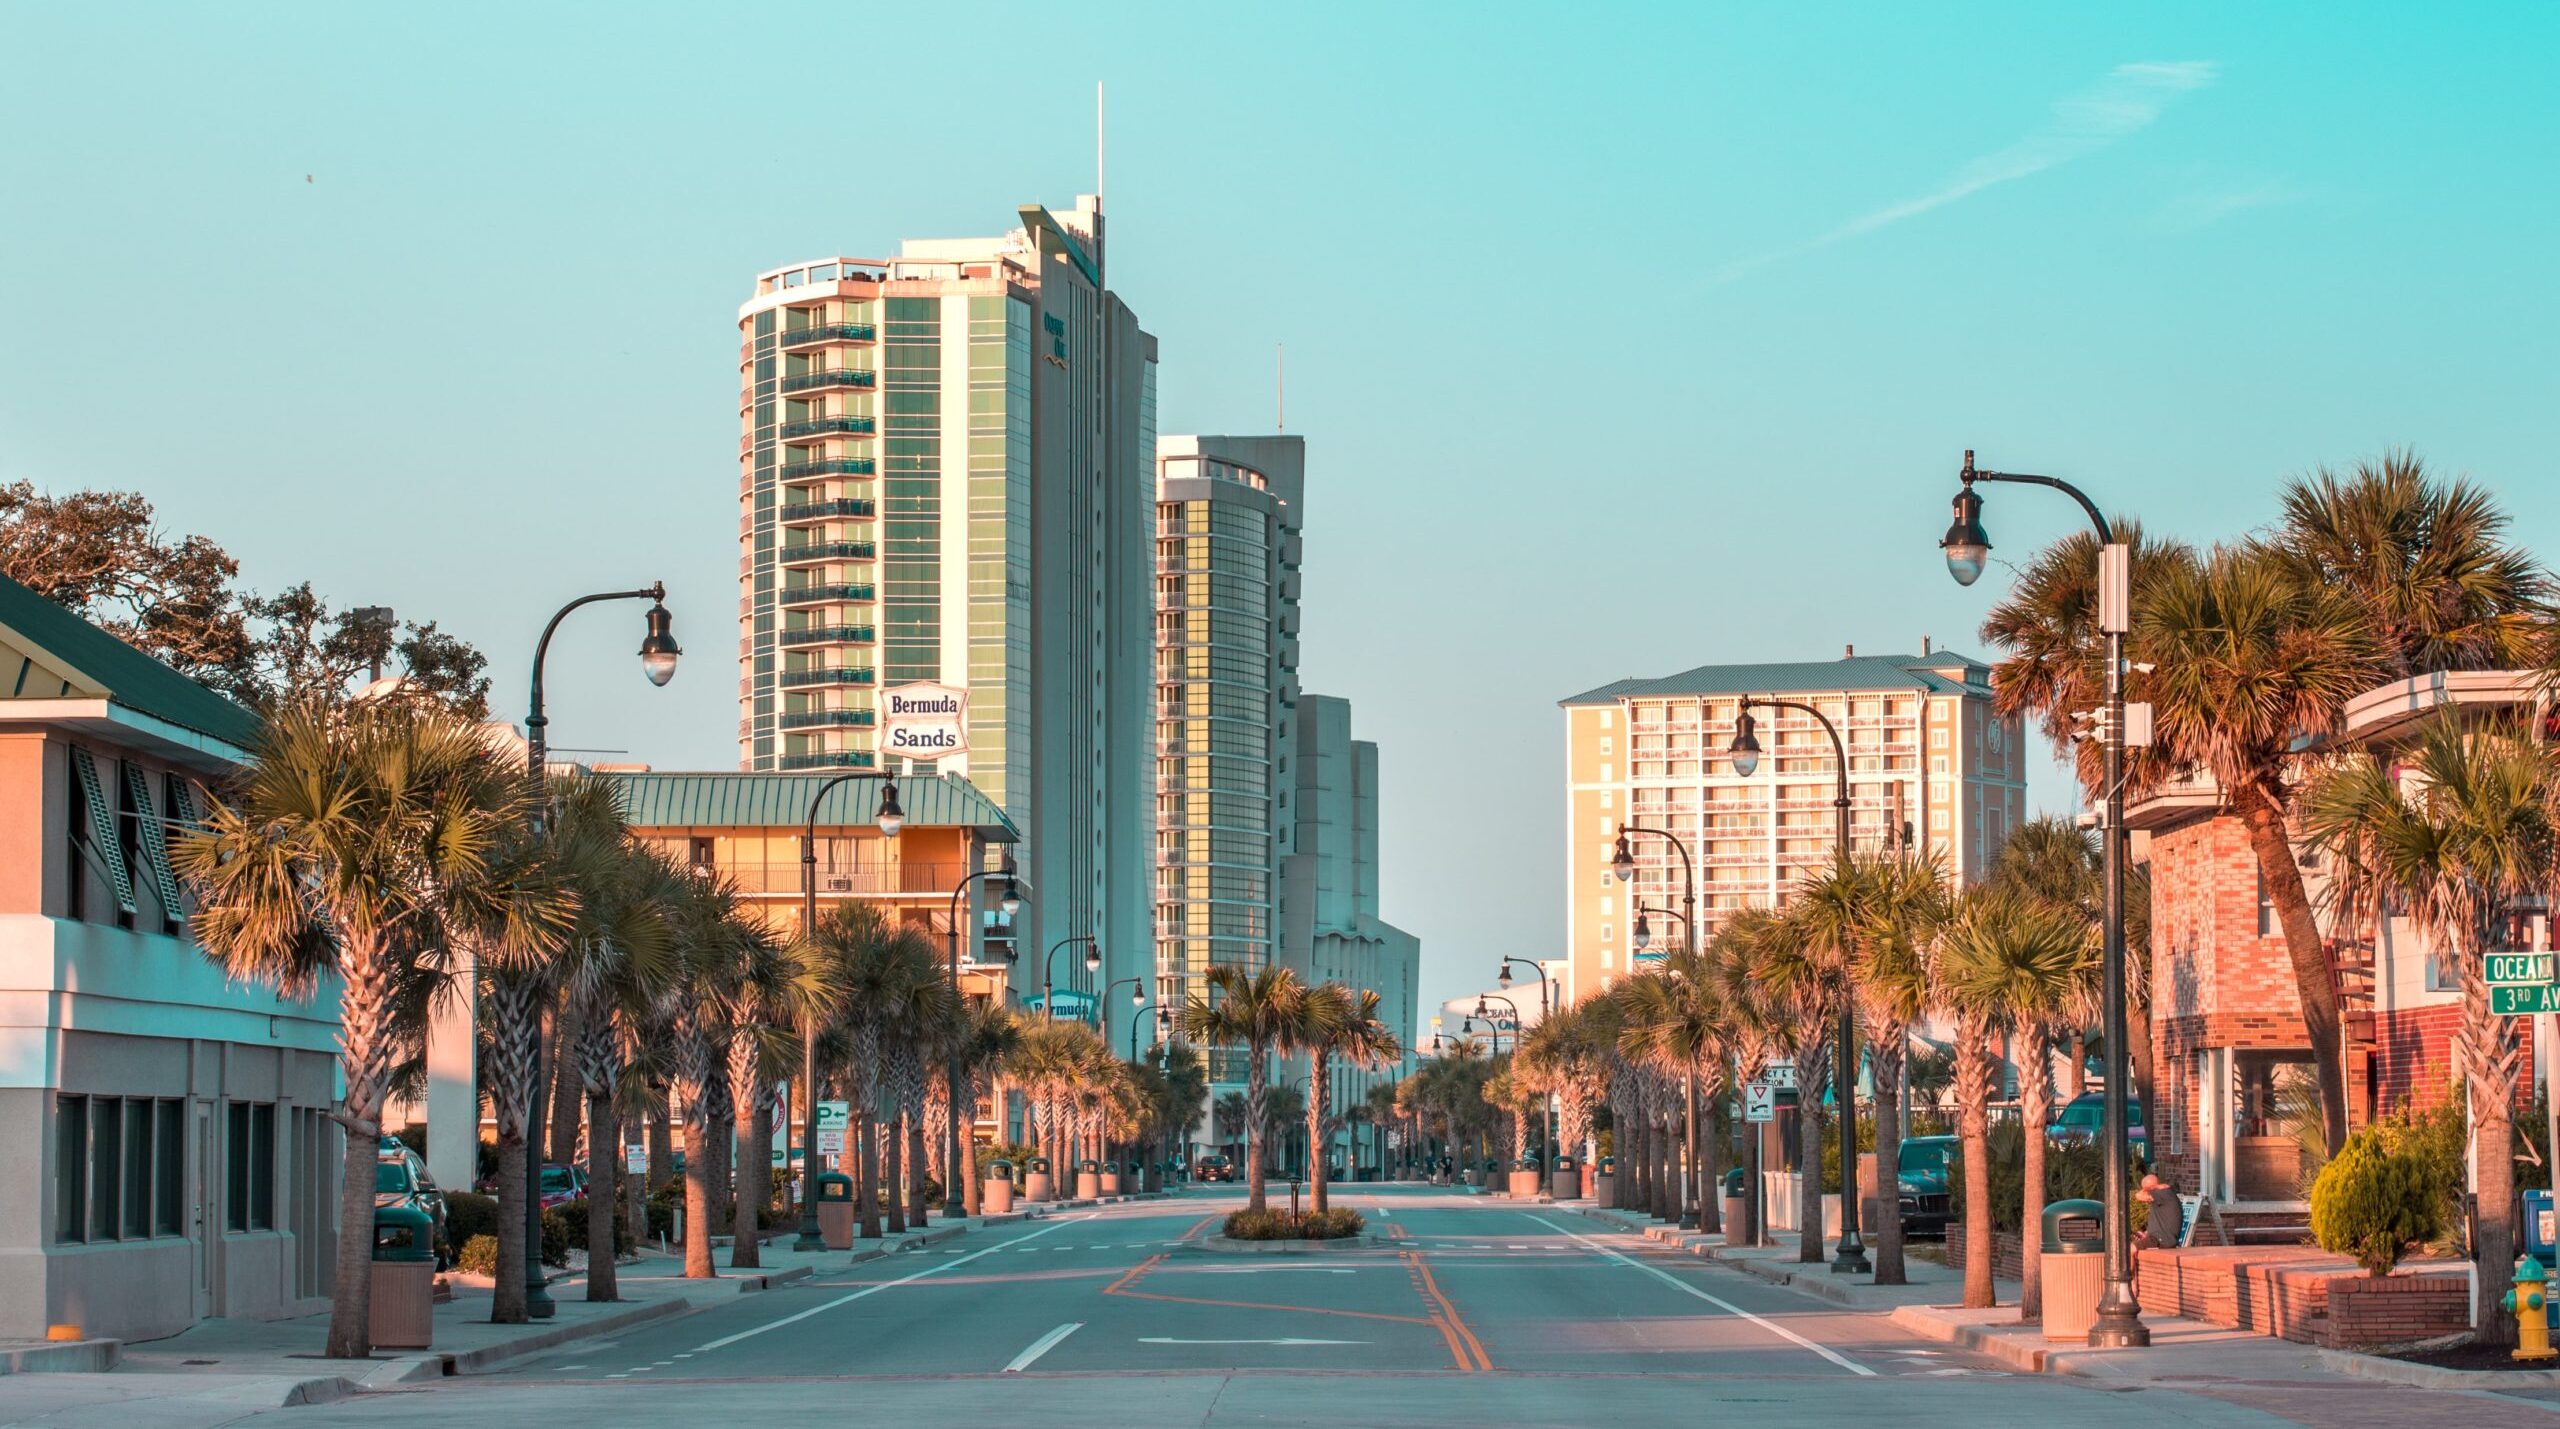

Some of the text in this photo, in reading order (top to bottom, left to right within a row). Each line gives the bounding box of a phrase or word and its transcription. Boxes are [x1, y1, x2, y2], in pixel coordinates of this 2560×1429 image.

[891, 694, 958, 714] Bermuda
[892, 727, 957, 748] Sands
[2506, 988, 2531, 1011] 3RD
